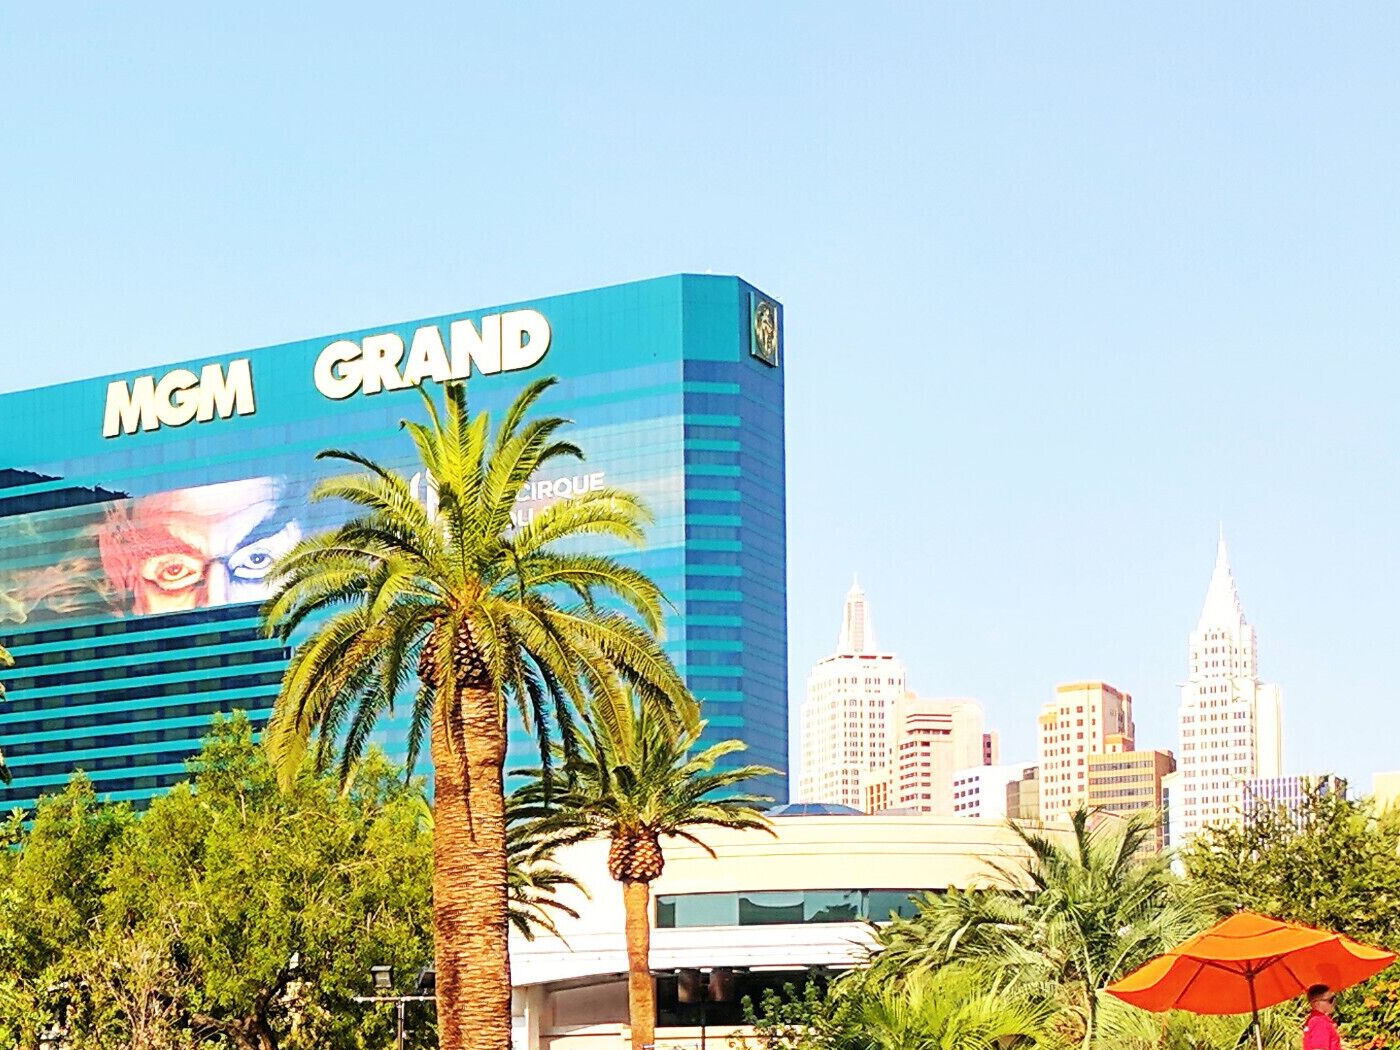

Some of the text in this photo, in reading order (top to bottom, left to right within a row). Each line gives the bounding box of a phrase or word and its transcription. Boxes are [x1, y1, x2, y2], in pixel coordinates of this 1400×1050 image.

[102, 309, 551, 438] MGM GRAND
[515, 472, 605, 502] CIRQUE
